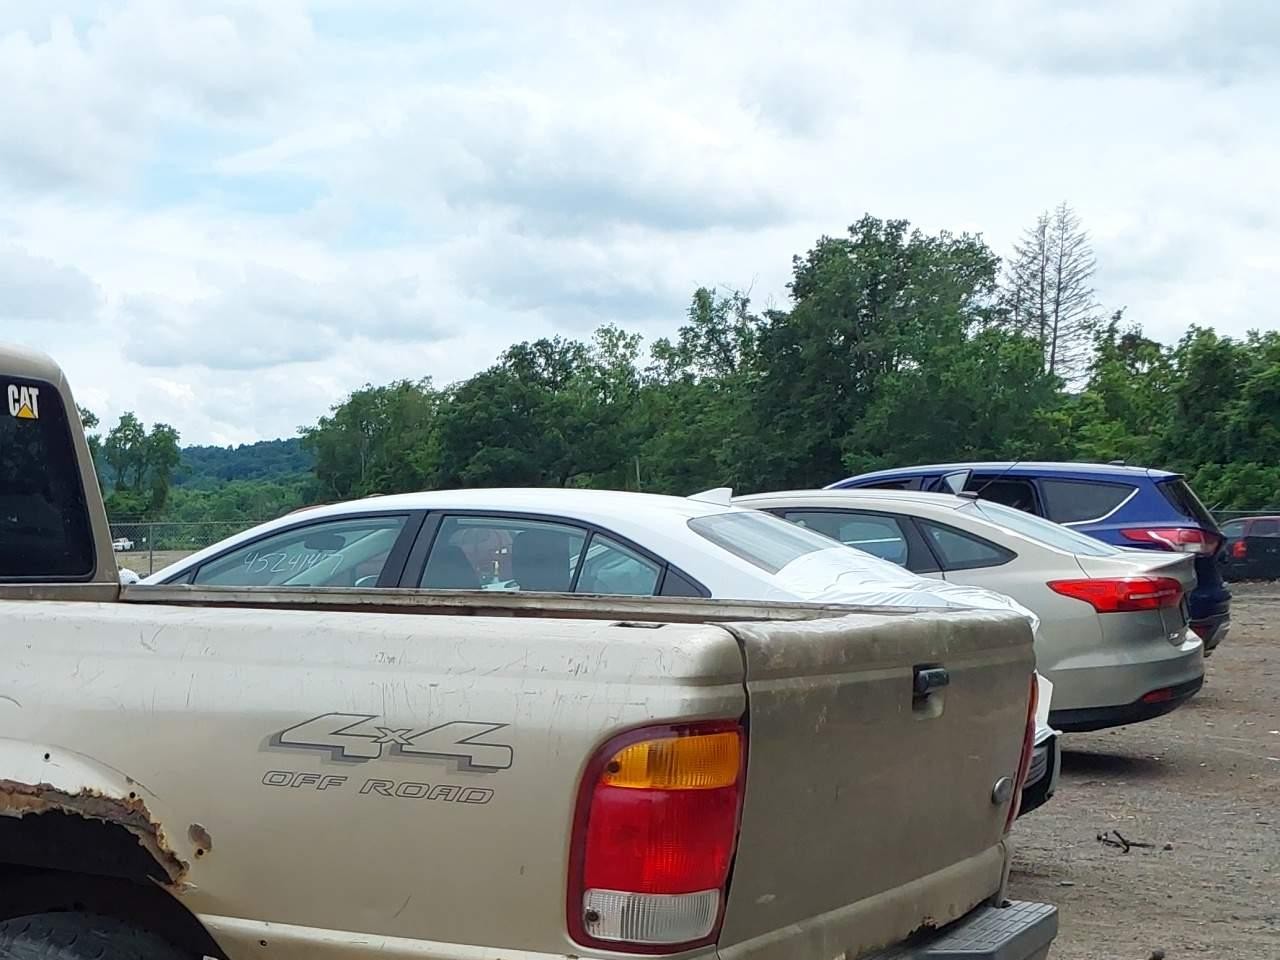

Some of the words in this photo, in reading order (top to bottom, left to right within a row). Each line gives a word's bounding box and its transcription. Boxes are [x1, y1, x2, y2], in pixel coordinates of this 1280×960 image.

[7, 384, 39, 419] CAT
[261, 770, 348, 791] OFF
[358, 778, 495, 804] ROAD
